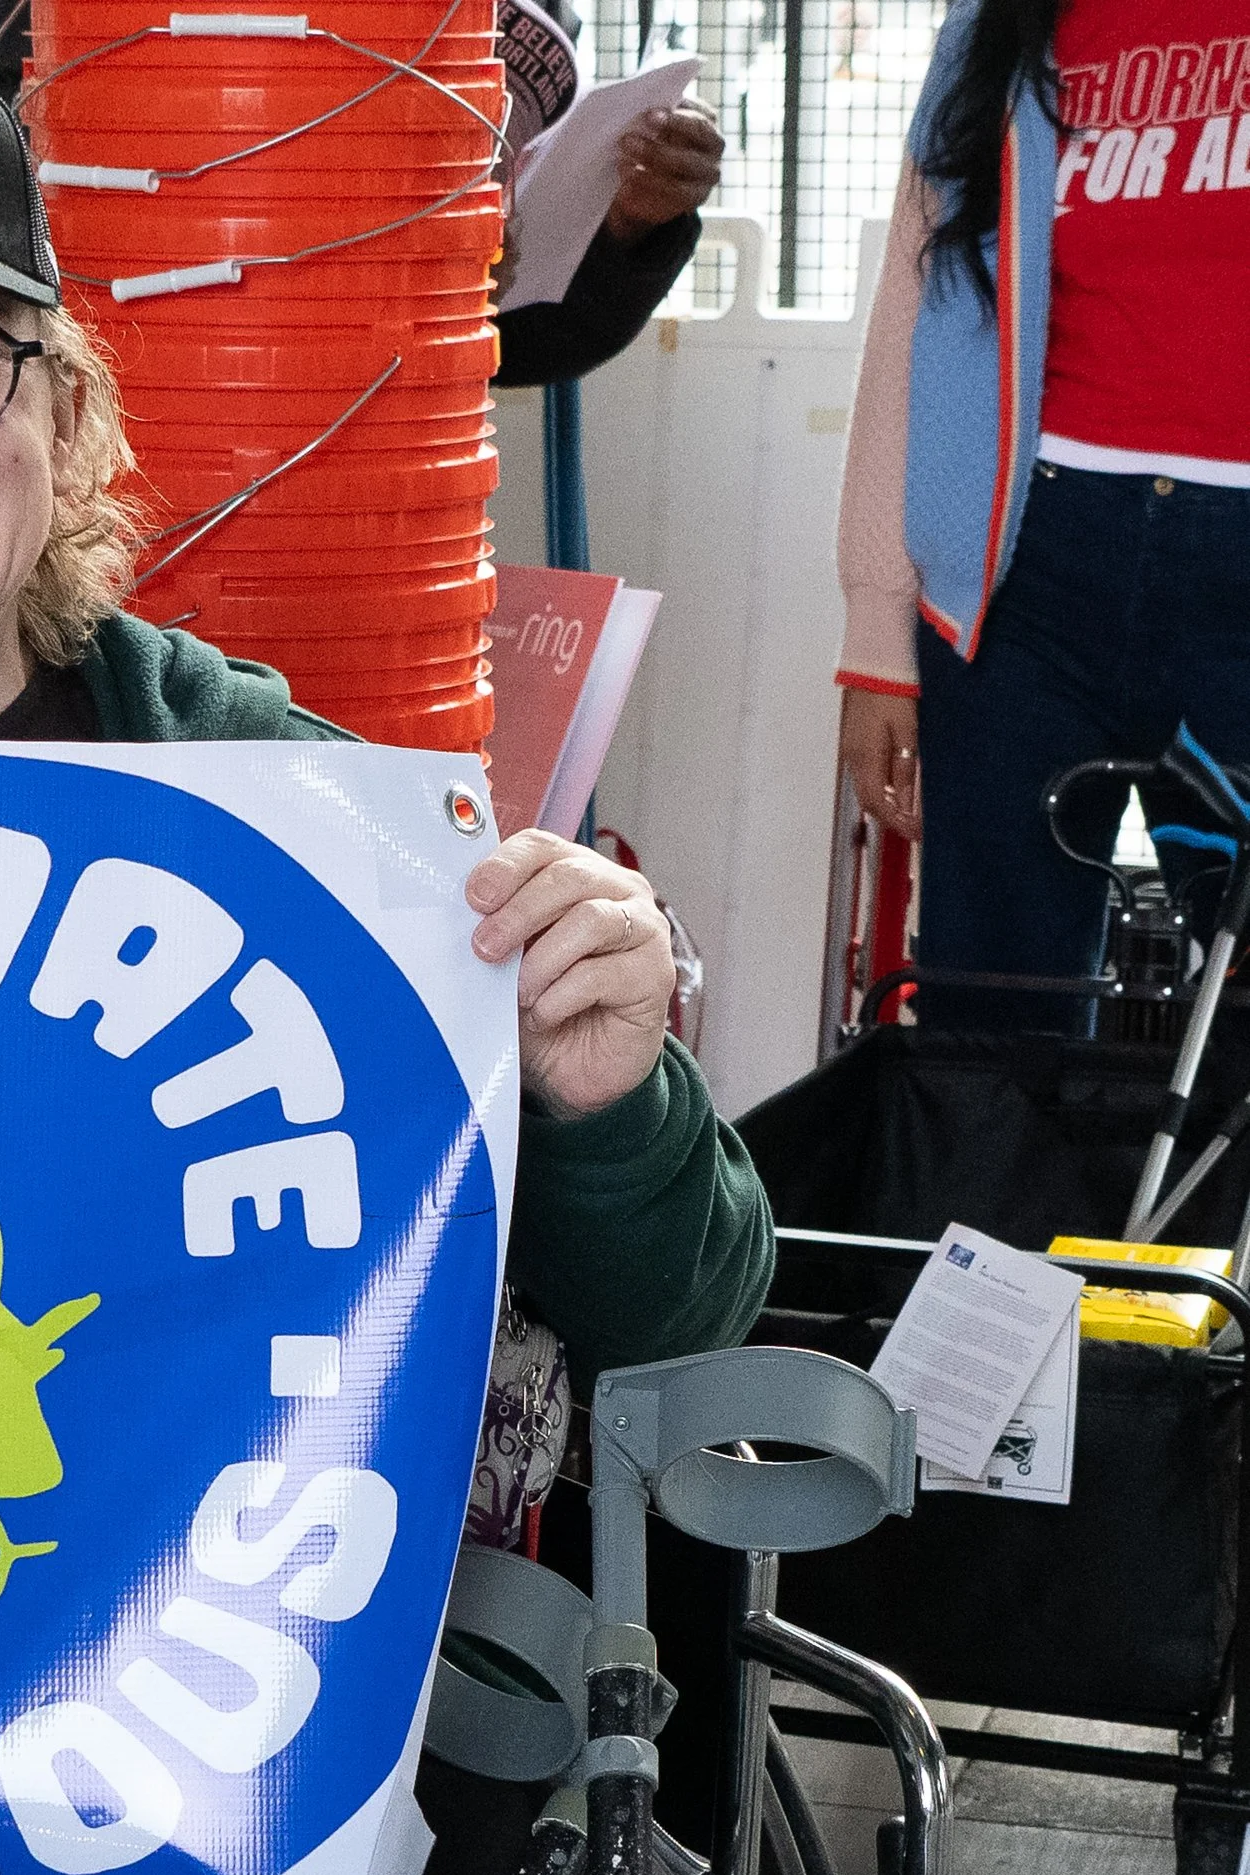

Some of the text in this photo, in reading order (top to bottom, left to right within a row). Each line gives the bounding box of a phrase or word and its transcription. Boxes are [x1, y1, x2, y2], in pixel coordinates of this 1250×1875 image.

[497, 36, 558, 115] ORTLAND
[511, 17, 574, 96] BELIEVE
[1055, 127, 1177, 203] FOR
[518, 602, 583, 675] ring
